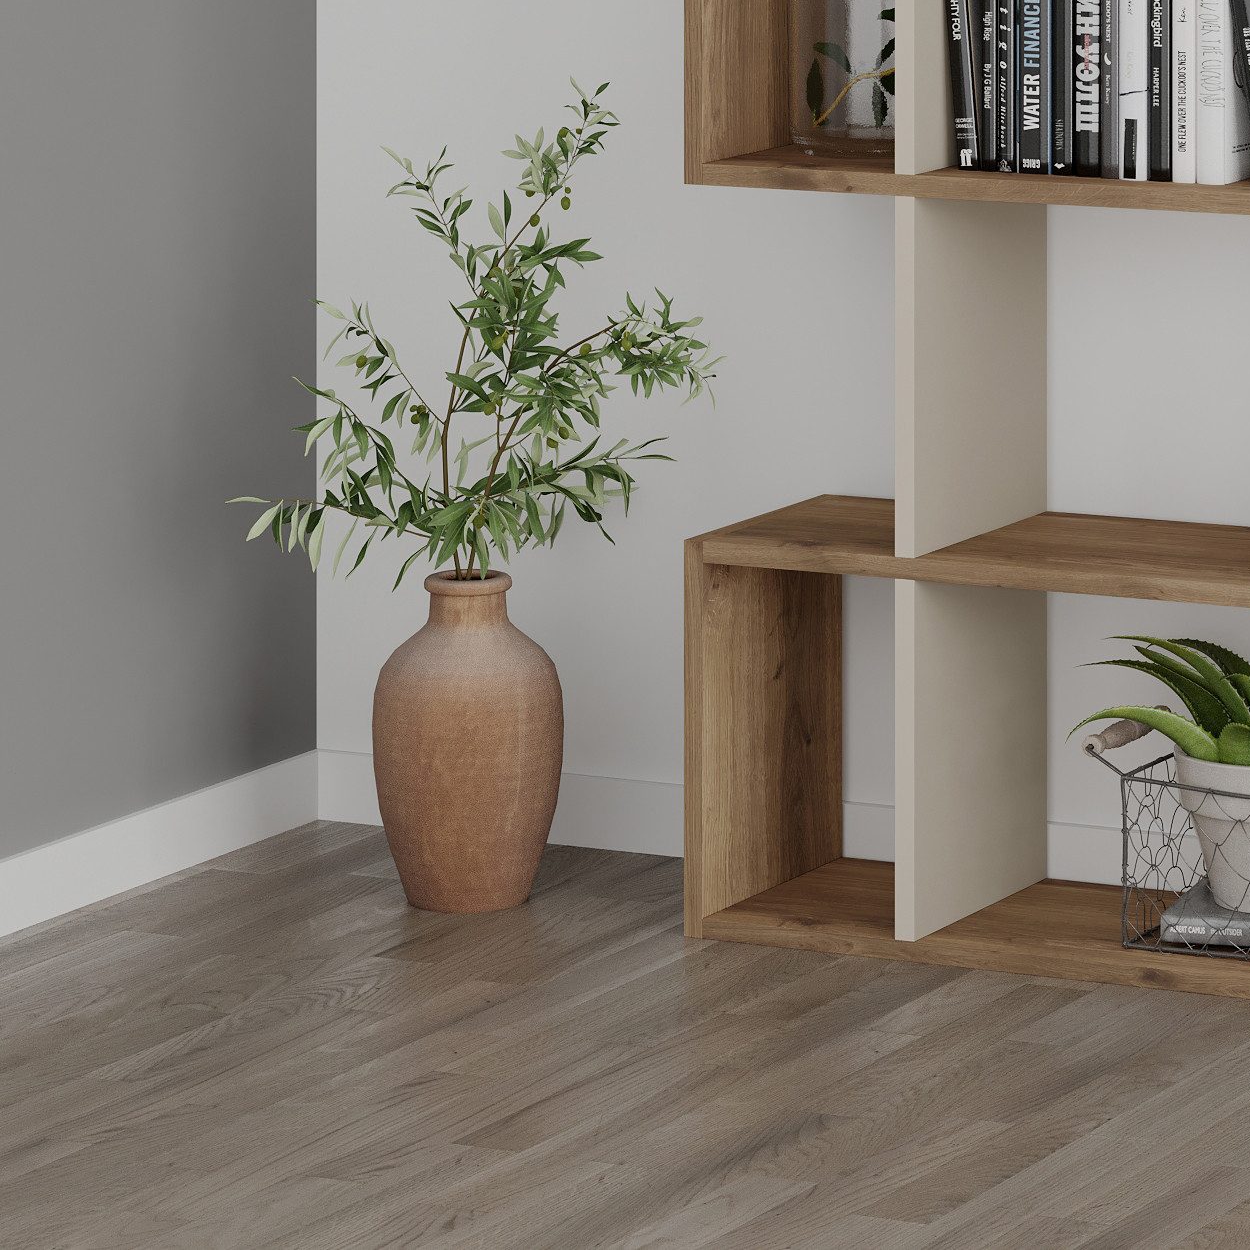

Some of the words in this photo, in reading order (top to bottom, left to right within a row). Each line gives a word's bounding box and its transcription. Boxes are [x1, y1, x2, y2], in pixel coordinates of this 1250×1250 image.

[982, 11, 993, 26] High
[951, 17, 961, 41] FOUR
[983, 27, 993, 41] Rise
[1177, 50, 1187, 66] NEST
[983, 63, 992, 72] By
[1075, 42, 1100, 132] УЭЛШ
[1177, 67, 1187, 95] CUCKOO'S
[984, 86, 992, 109] Ballard
[1023, 73, 1040, 131] WATER
[1177, 96, 1187, 106] THE
[1177, 107, 1187, 123] OVER
[1177, 124, 1187, 140] FLEW
[1177, 141, 1187, 153] ONE
[1188, 926, 1206, 935] CAMUS
